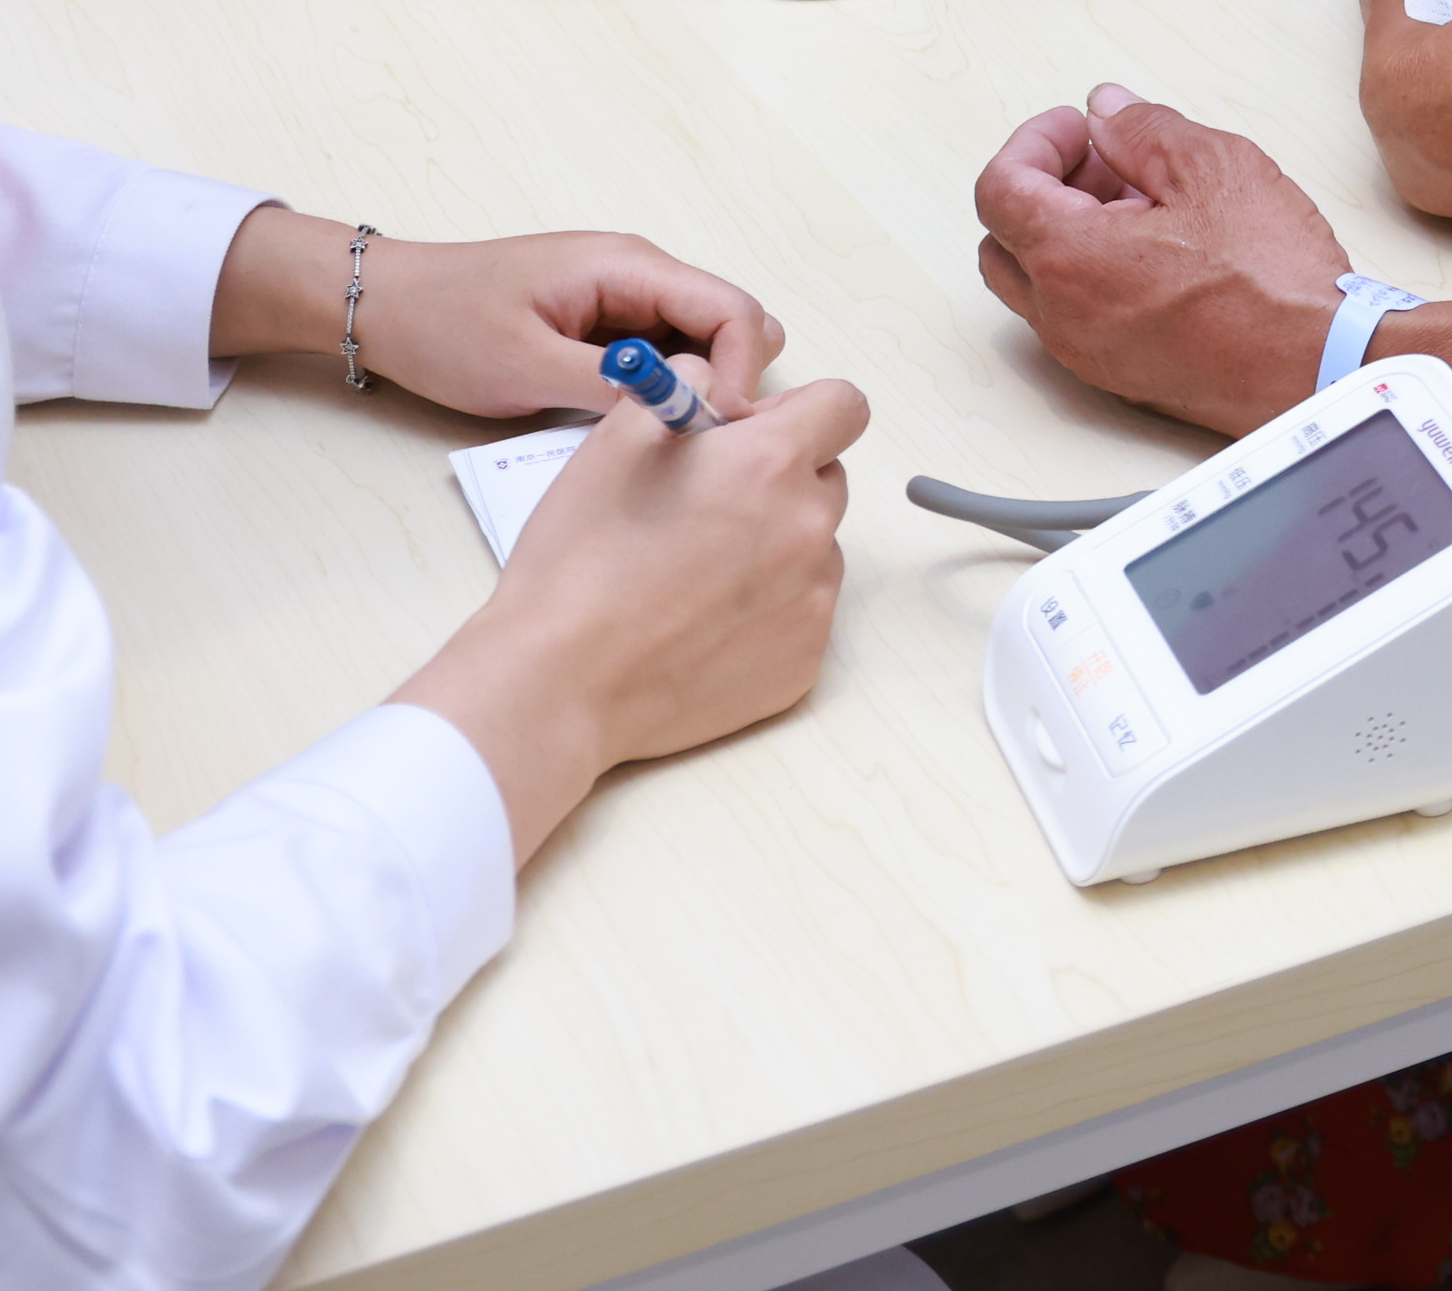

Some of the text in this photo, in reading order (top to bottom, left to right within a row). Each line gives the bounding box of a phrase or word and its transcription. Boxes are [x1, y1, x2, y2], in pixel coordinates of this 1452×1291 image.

[1300, 422, 1327, 447] 高压
[1229, 466, 1252, 491] 低压
[1317, 477, 1419, 571] 145
[1039, 595, 1068, 632] 设置
[1108, 713, 1137, 753] 记忆
